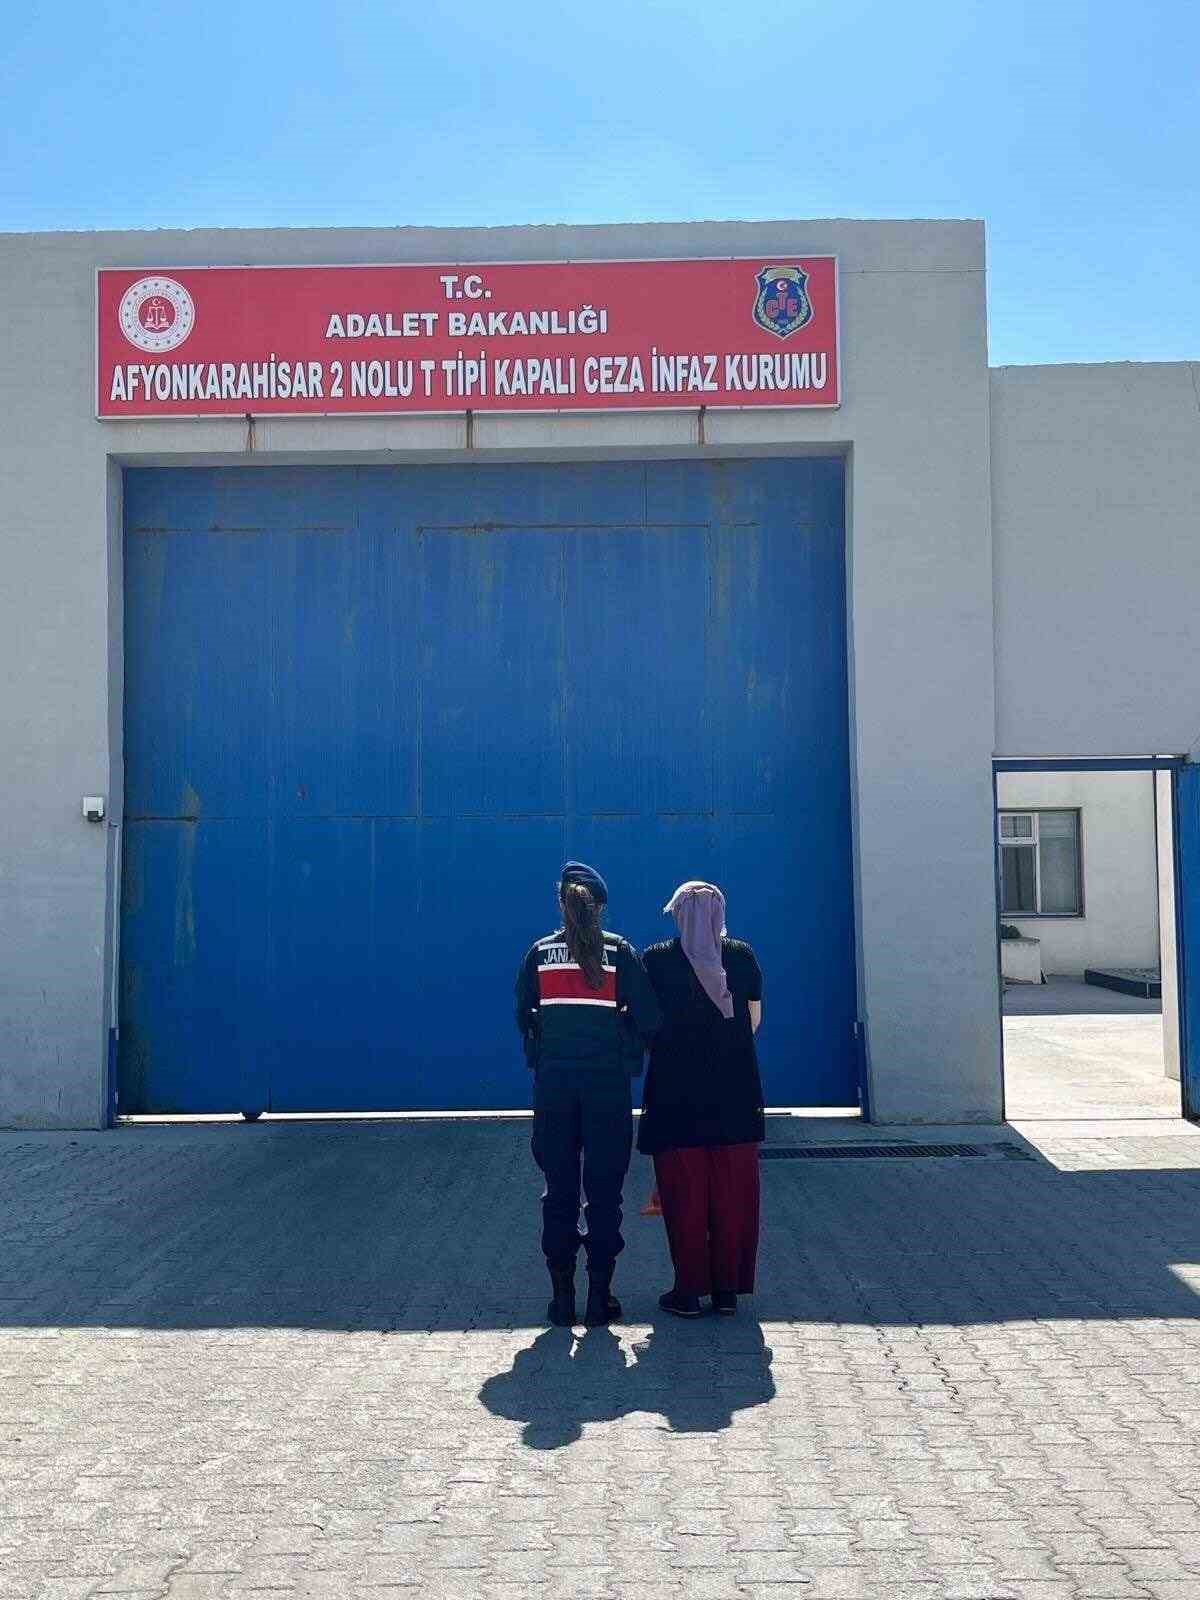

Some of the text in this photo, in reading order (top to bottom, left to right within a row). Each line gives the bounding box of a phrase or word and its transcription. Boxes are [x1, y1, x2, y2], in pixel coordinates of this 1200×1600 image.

[440, 275, 492, 299] T.C.
[325, 304, 608, 338] ADALET BAKANLIĞI
[110, 346, 827, 401] AFYONKARAHİSAR 2 NOLU T TİPİ KAPALI CEZA İNFAZ KURUMU
[543, 948, 609, 967] JANA
